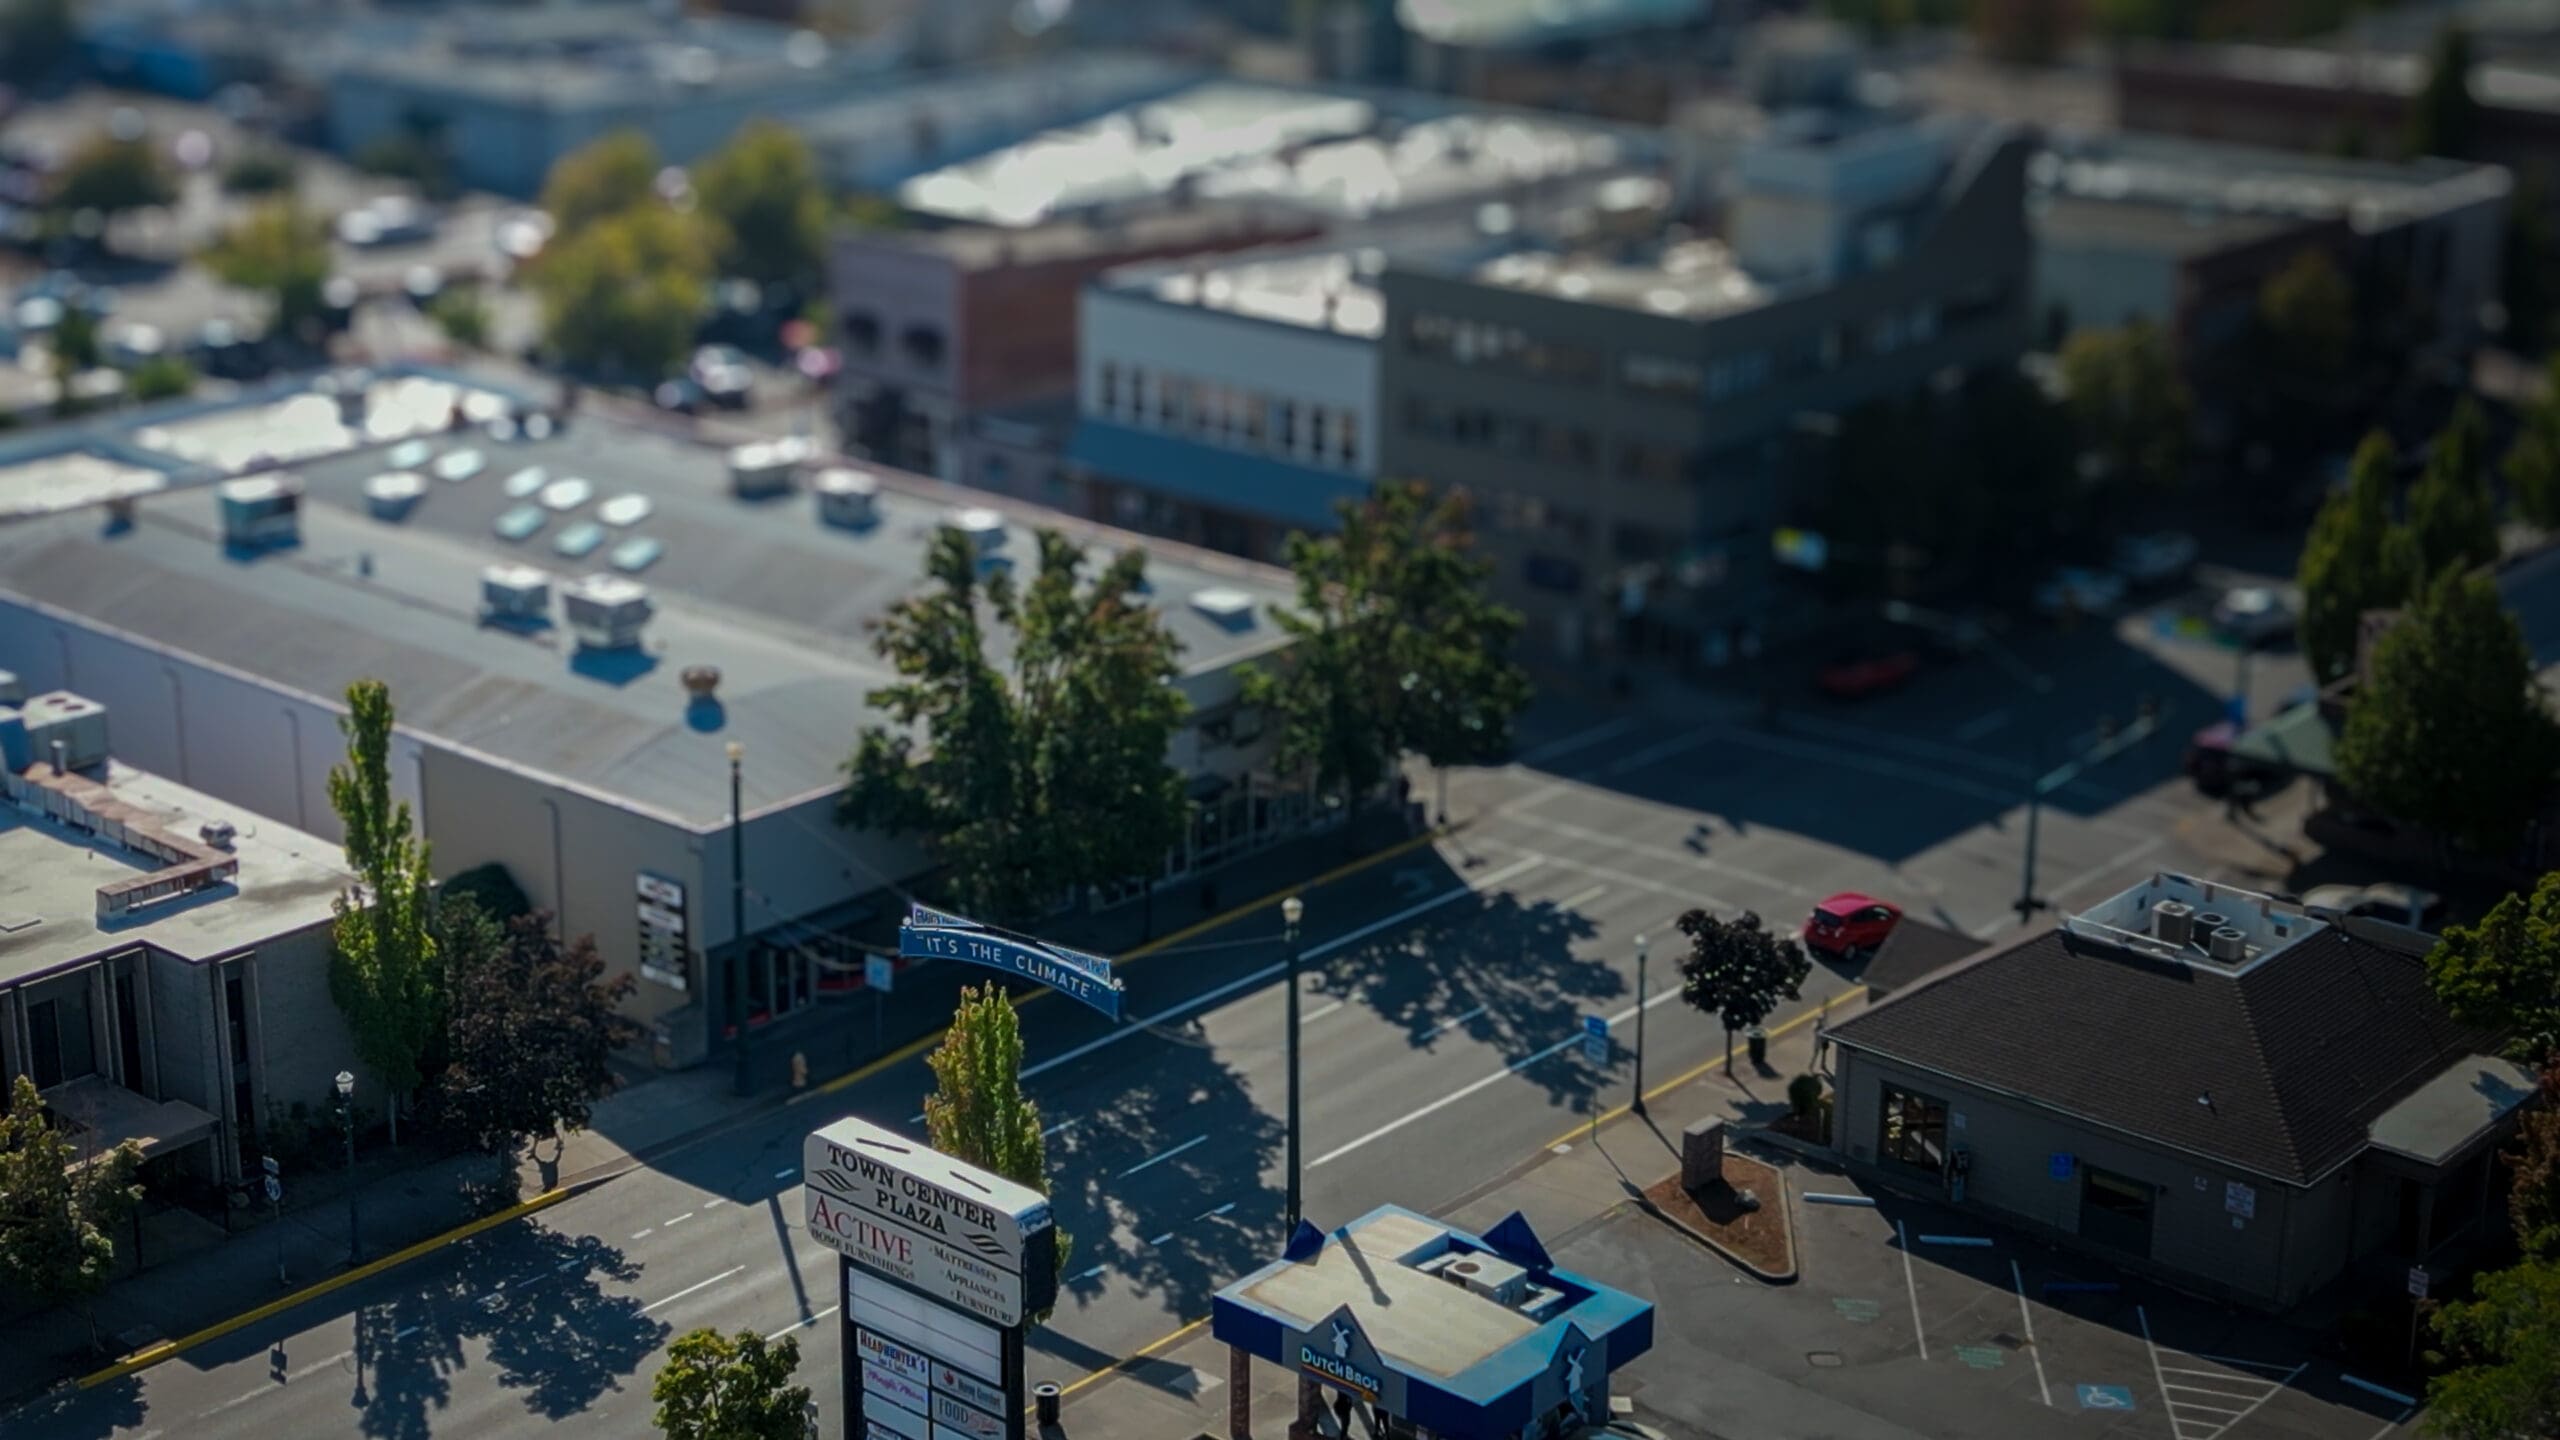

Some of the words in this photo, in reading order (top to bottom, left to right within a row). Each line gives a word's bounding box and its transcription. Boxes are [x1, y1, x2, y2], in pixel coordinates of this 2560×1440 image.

[969, 941, 1002, 963] THE
[827, 1144, 895, 1188] TOWN
[902, 1178, 997, 1232] CENTER
[876, 1188, 947, 1235] PLAZA
[811, 1194, 914, 1265] ACTIVE
[811, 1227, 840, 1248] HOME
[844, 1241, 914, 1280] FURNISHINGS
[934, 1245, 998, 1283] MATTRESSES
[945, 1269, 1006, 1304] APPLIANCES
[956, 1289, 1015, 1324] FURNITURE
[1301, 1346, 1344, 1378] DUTCH
[1345, 1365, 1379, 1393] BROS
